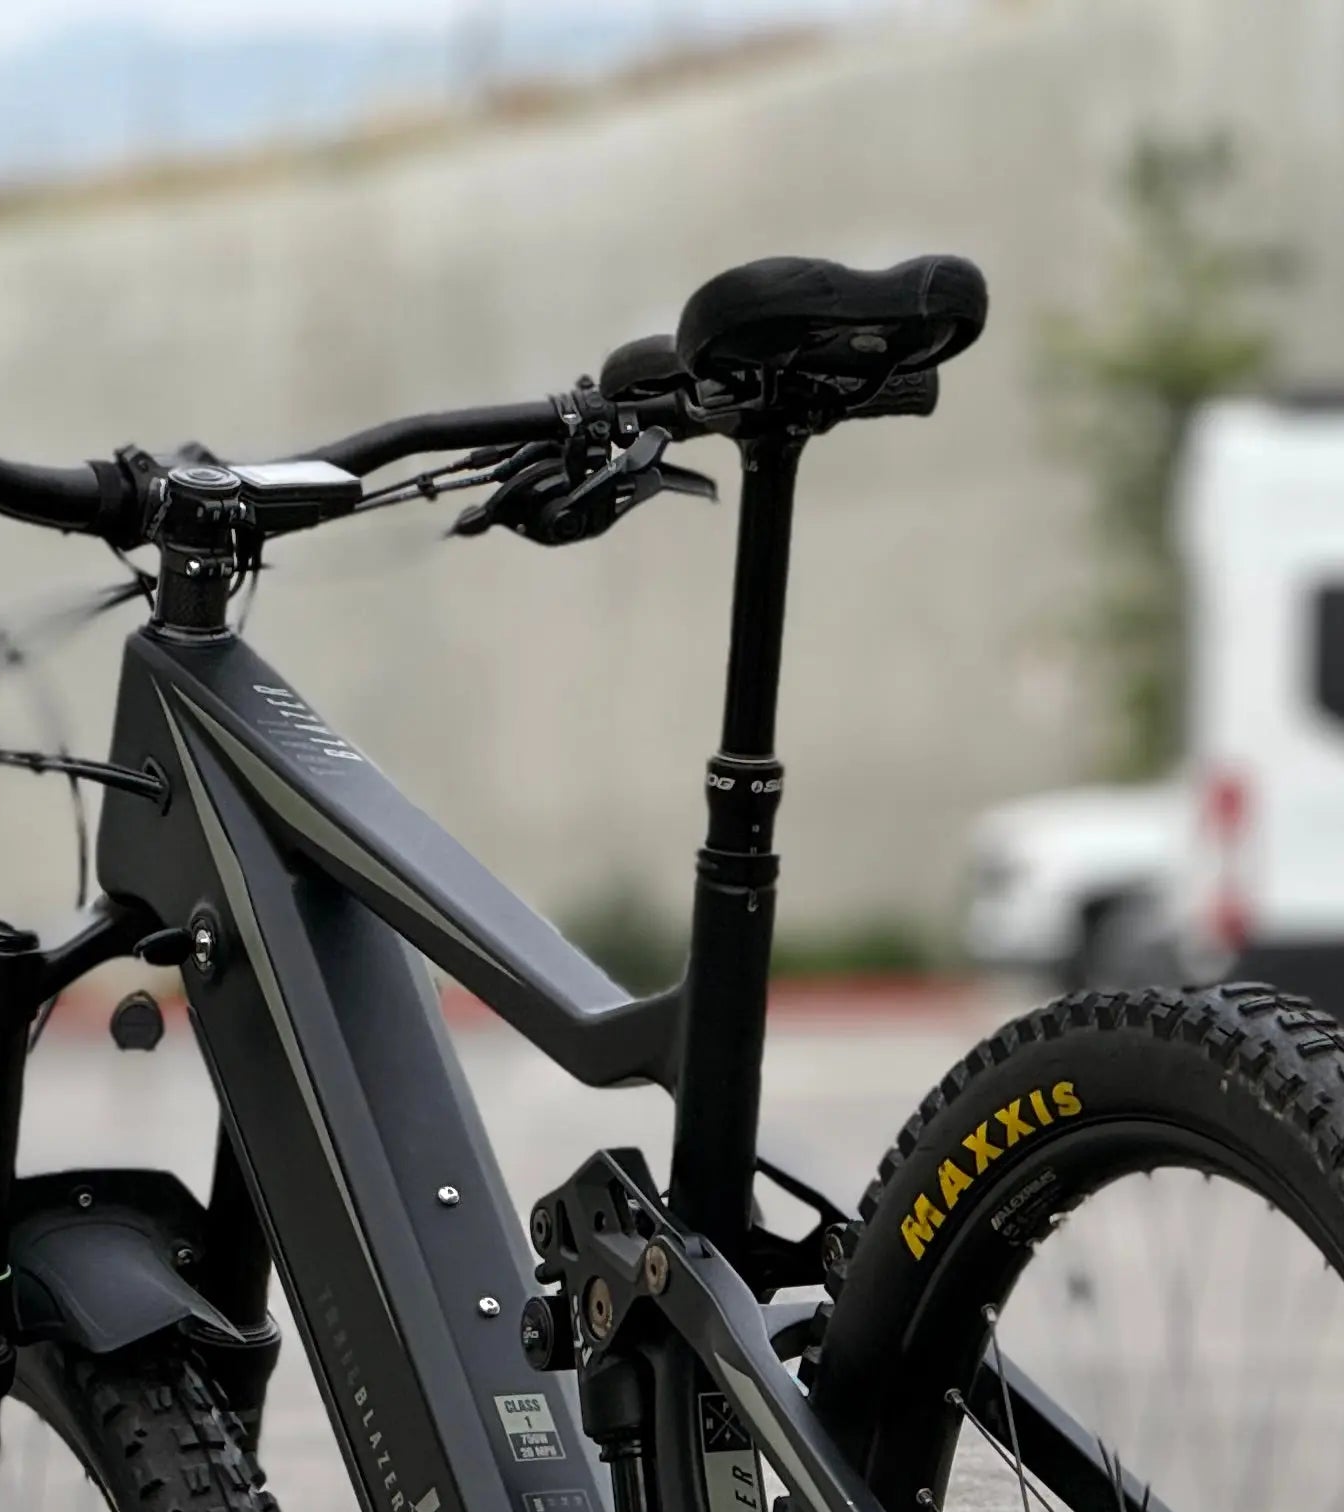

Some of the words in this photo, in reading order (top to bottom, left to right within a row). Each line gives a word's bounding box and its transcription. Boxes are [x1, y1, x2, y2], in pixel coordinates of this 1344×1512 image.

[253, 685, 363, 761] BLAZER
[901, 1081, 1082, 1260] MAXXIS
[504, 1398, 542, 1413] CLASS
[523, 1415, 533, 1430] 1
[354, 1384, 405, 1512] BLAZER
